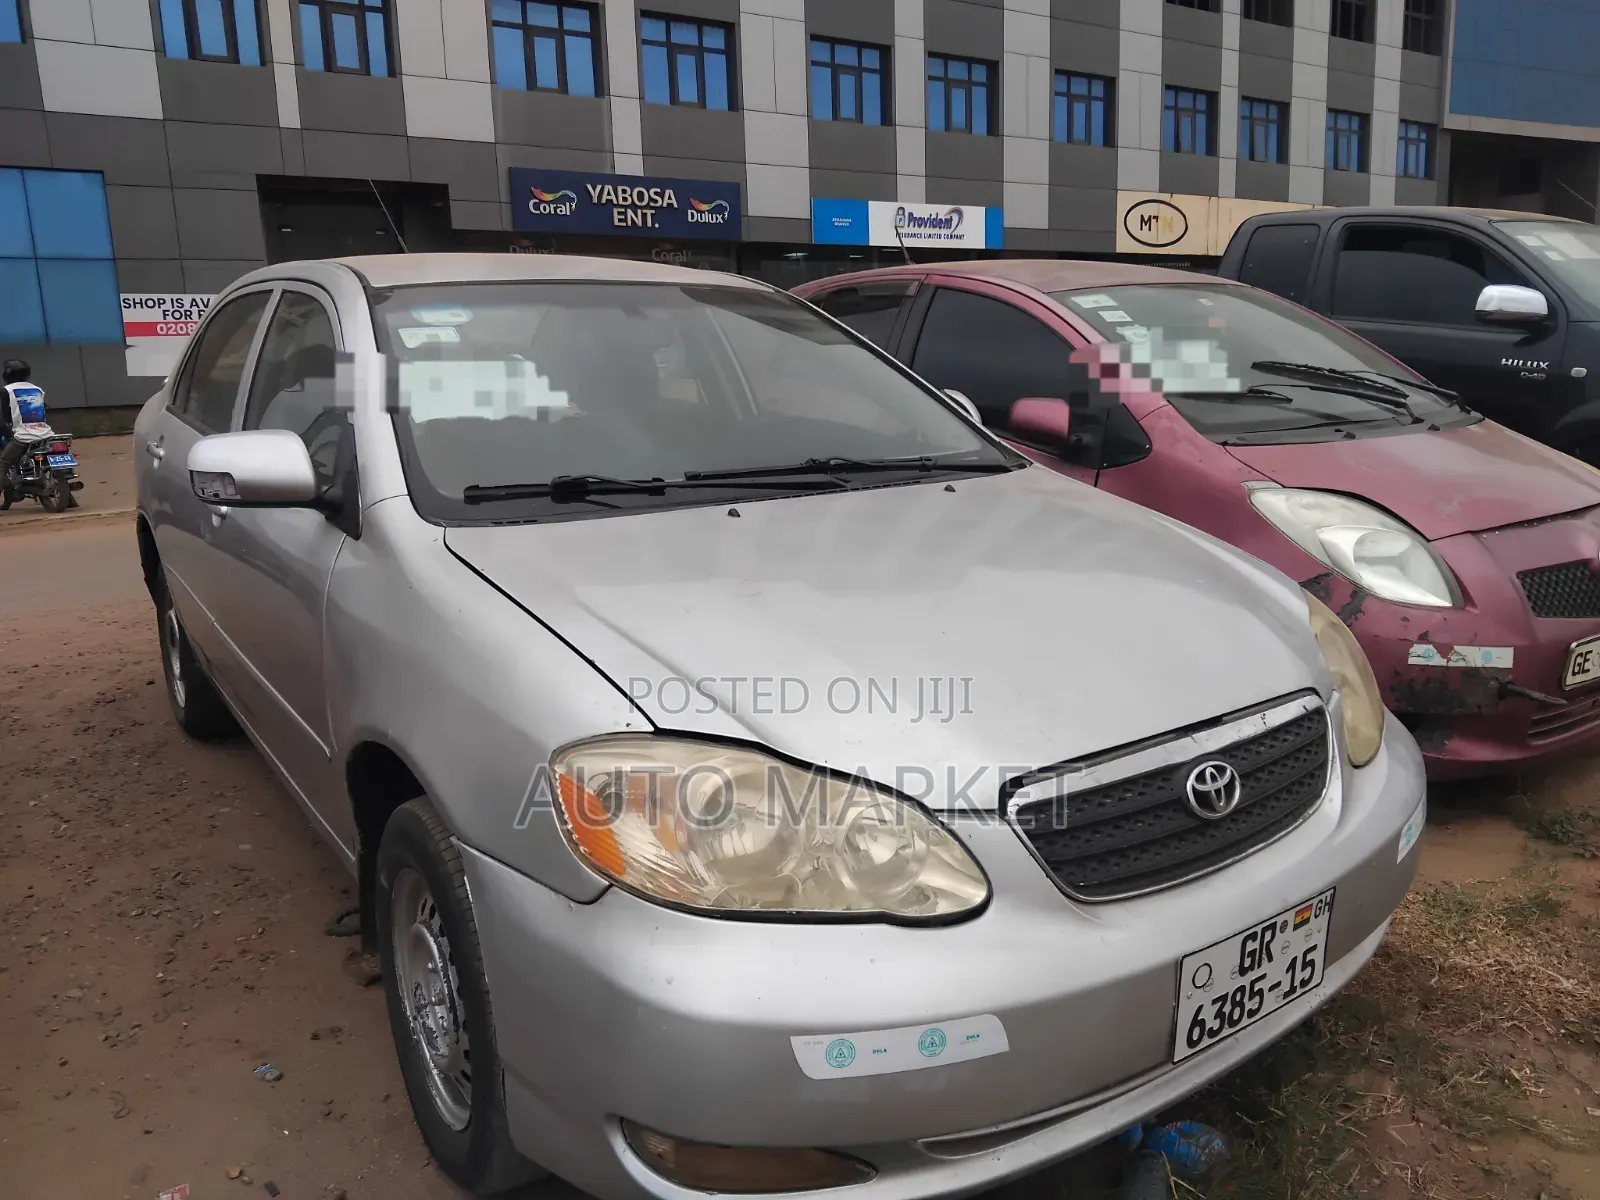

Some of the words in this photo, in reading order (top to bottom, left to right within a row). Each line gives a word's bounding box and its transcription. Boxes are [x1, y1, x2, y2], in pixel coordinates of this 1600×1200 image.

[586, 184, 678, 208] YABOSA
[528, 199, 571, 216] Coral
[687, 209, 724, 224] Dulux
[612, 208, 660, 228] ENT.
[907, 211, 954, 230] Provident
[923, 232, 943, 240] LIMITED
[651, 249, 687, 263] Coral
[122, 297, 167, 309] SHOP
[170, 297, 185, 309] IS
[162, 309, 193, 321] FOR
[1501, 358, 1549, 370] HILUX
[1571, 649, 1594, 677] GE
[1313, 892, 1333, 921] GH
[1238, 920, 1278, 977] GR
[1186, 943, 1318, 1049] 6385-15
